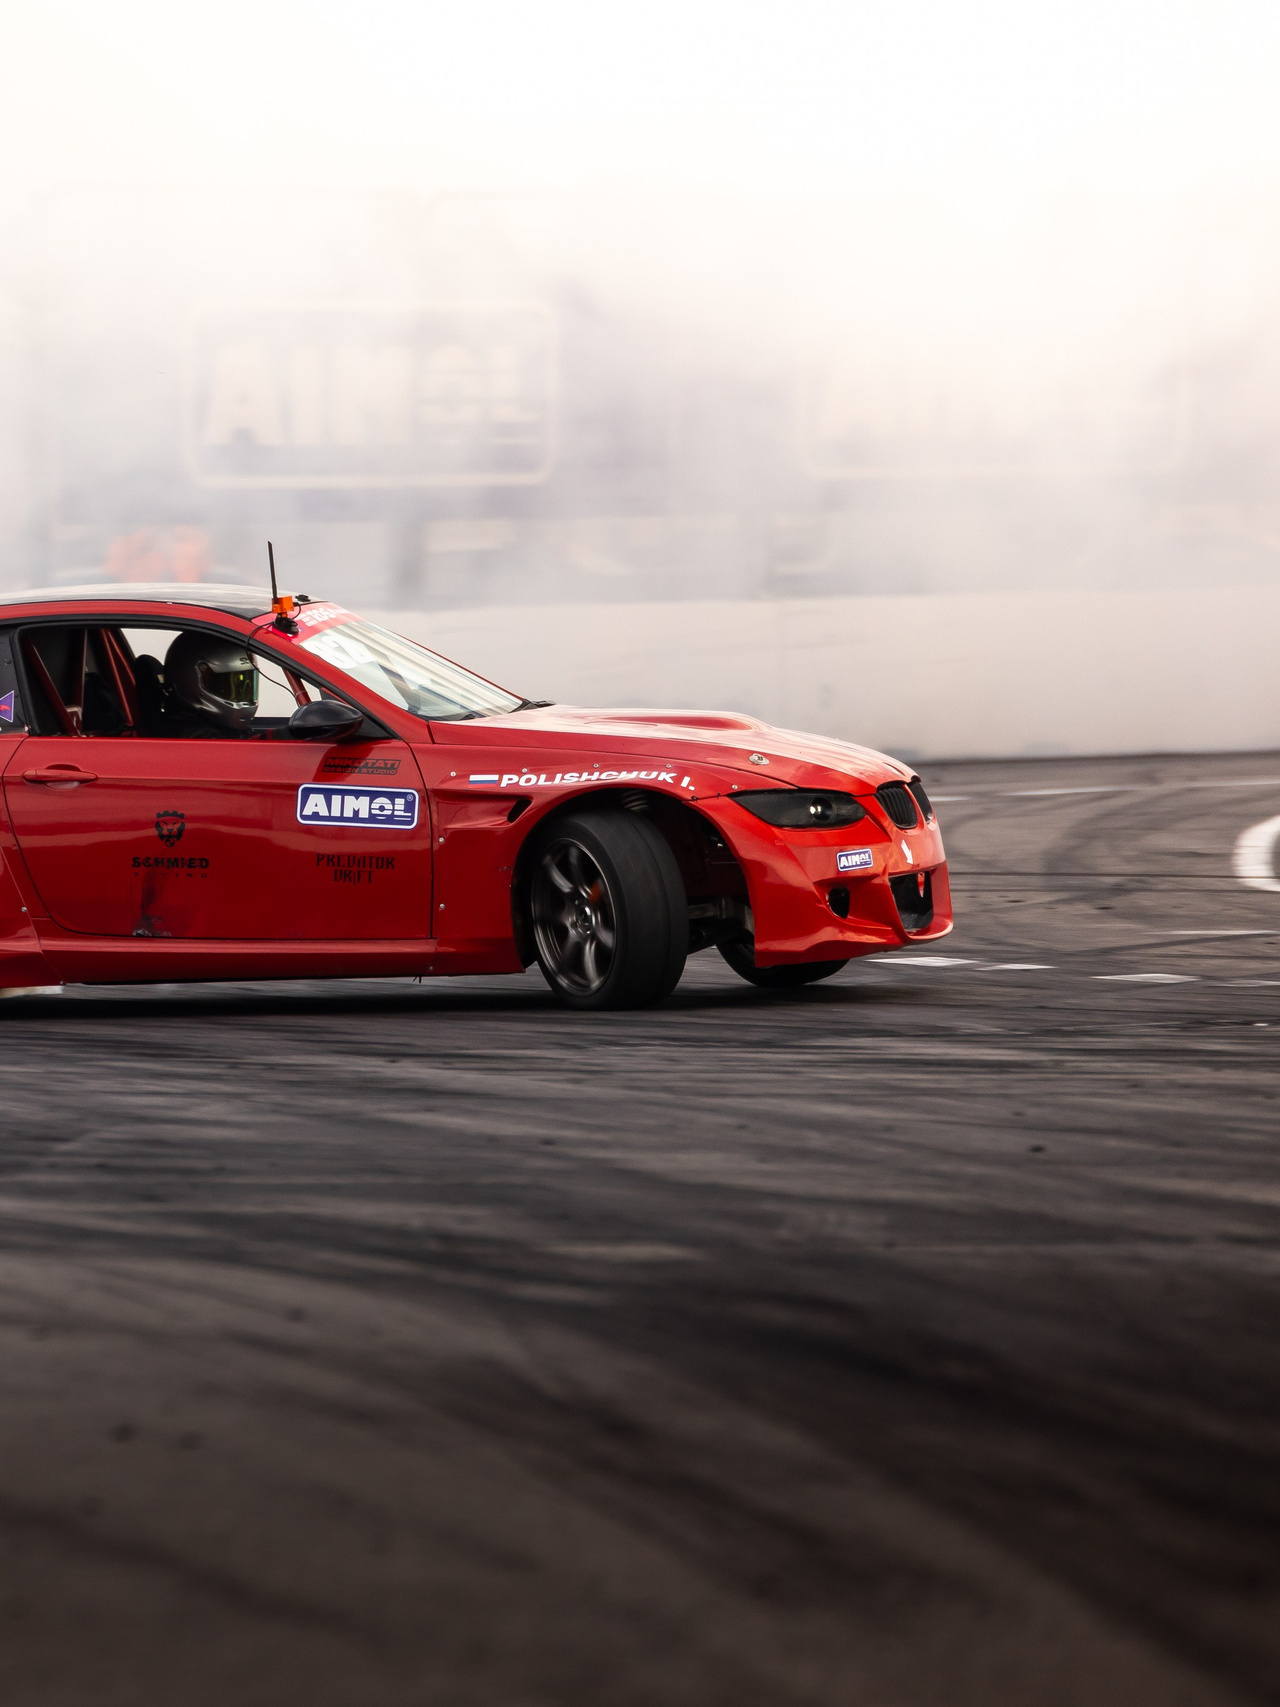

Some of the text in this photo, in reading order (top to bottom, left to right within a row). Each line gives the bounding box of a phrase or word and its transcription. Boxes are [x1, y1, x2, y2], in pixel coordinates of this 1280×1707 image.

[202, 344, 539, 449] AIMOL
[323, 766, 359, 774] DESIGN
[326, 757, 401, 769] MIKOTATI
[499, 771, 696, 791] POLISHCHUK I.
[301, 793, 412, 821] AIMOL
[131, 856, 210, 869] SCHMIED
[316, 853, 395, 870] PREDATOR
[840, 853, 871, 867] AIMOL
[333, 868, 376, 886] DRIFT
